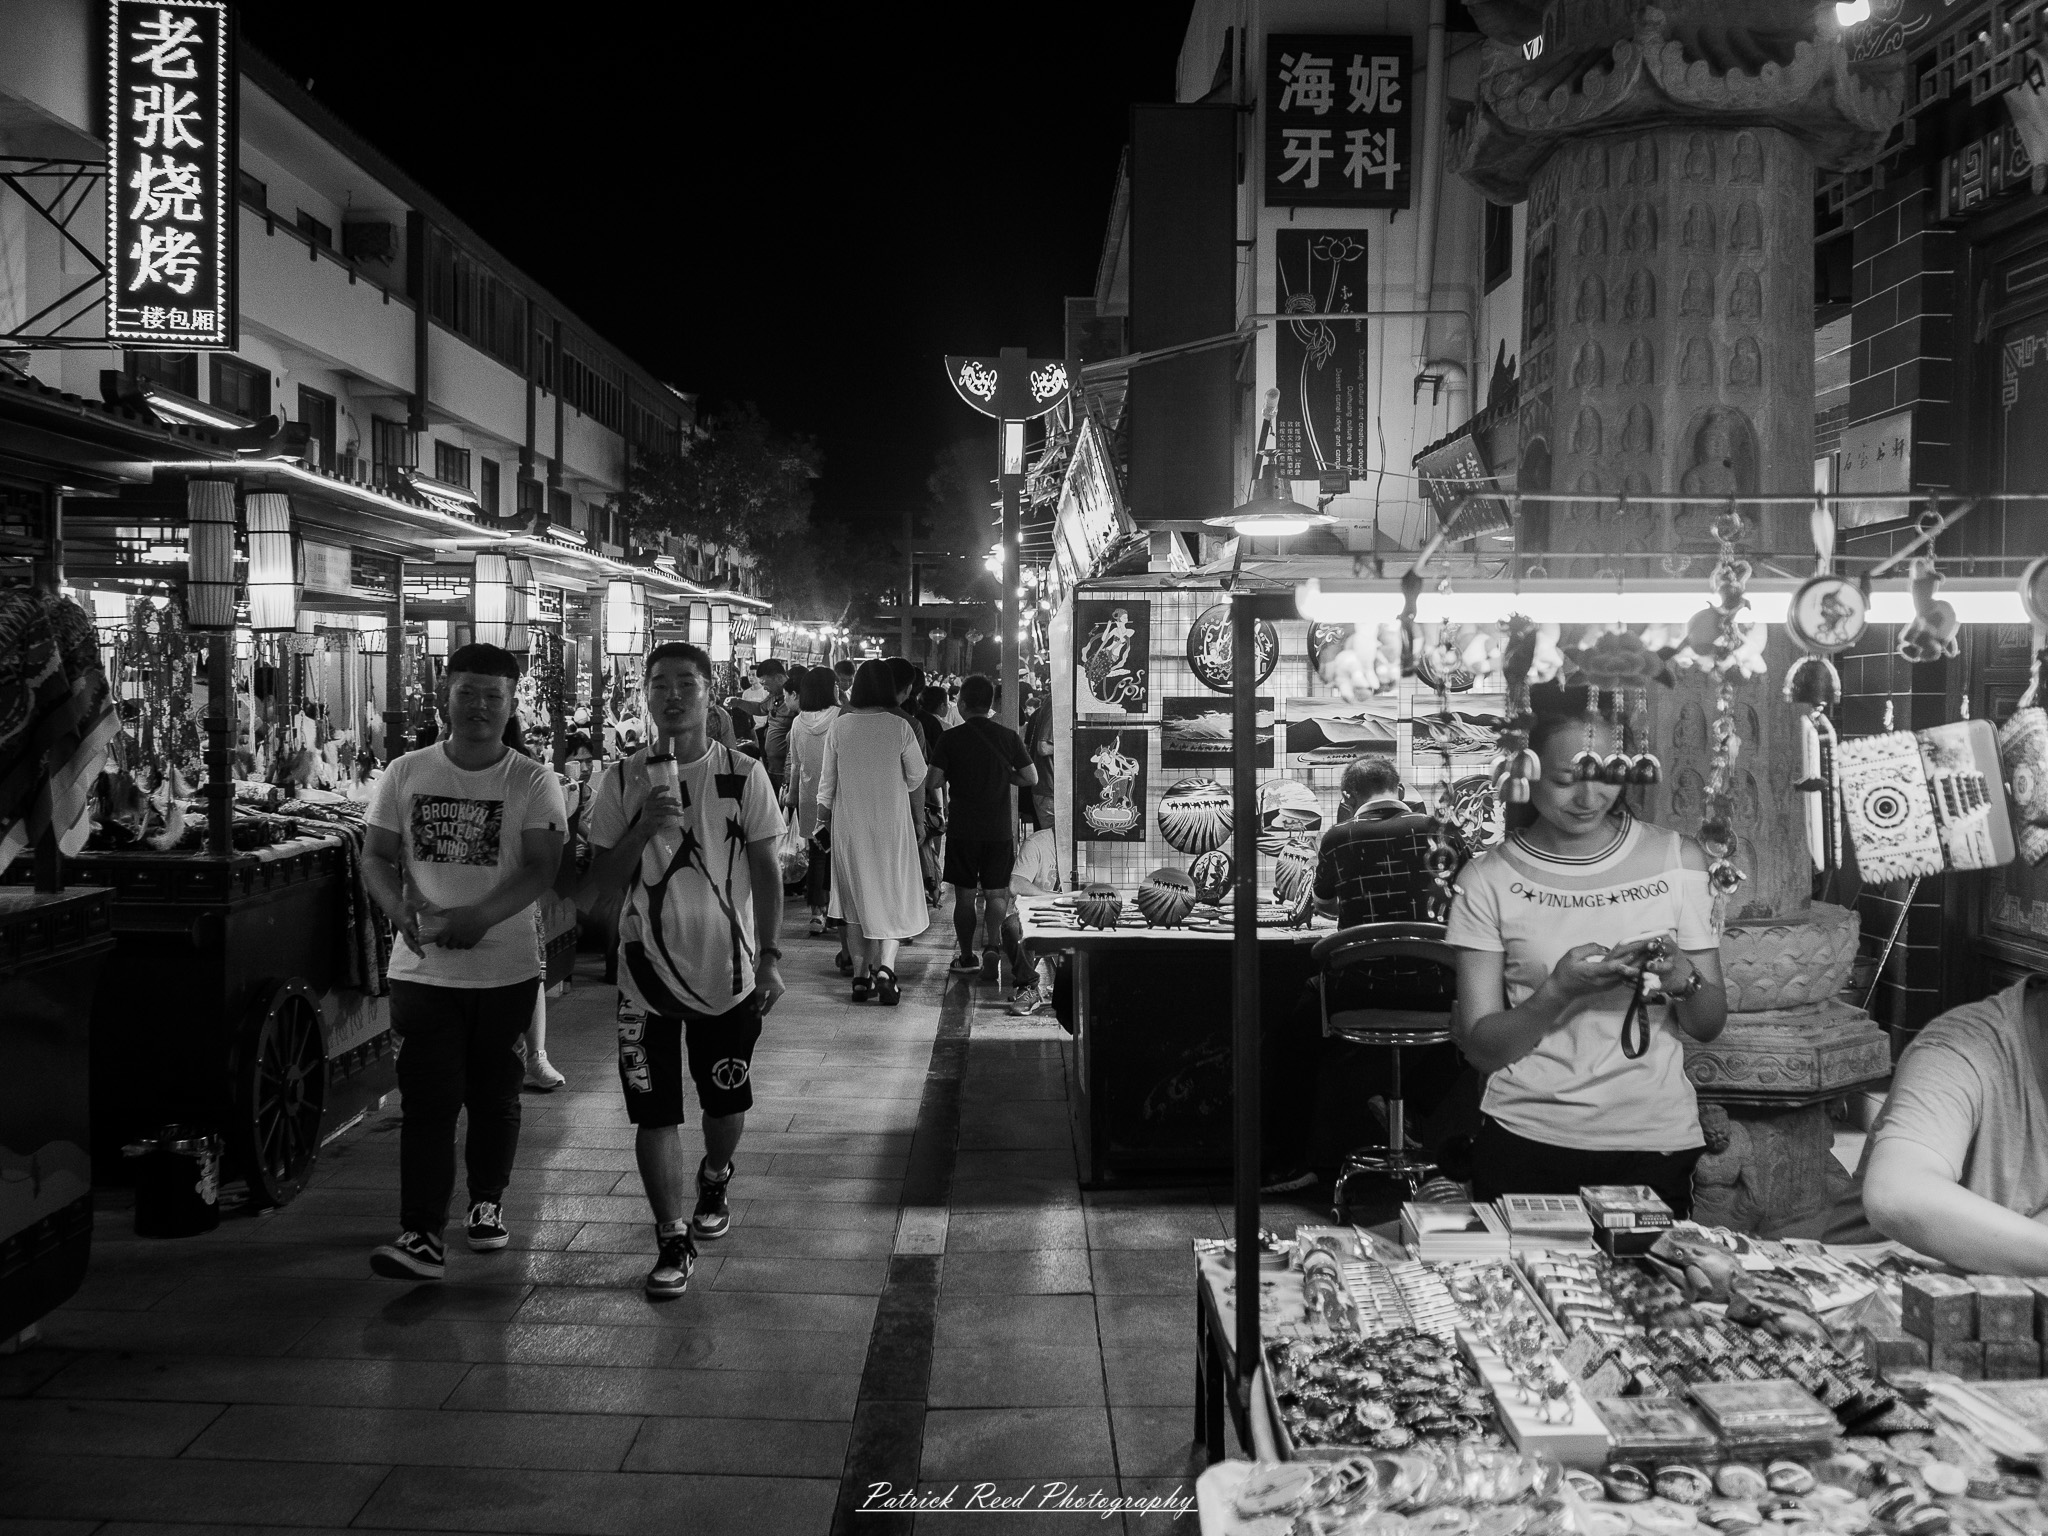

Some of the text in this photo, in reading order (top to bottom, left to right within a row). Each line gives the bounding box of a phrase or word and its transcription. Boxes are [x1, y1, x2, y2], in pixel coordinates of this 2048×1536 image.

[1278, 51, 1403, 116] 海妮
[128, 8, 204, 296] 老张烧烤
[1277, 127, 1402, 191] 牙科
[117, 305, 216, 331] 二楼包厢
[1345, 385, 1354, 418] Dunhuang
[1356, 348, 1366, 476] Dunhuang cultural and creative products
[1346, 419, 1354, 441] culture
[421, 802, 489, 825] BROOKLYN
[424, 821, 465, 839] STATE
[436, 839, 468, 857] MIND
